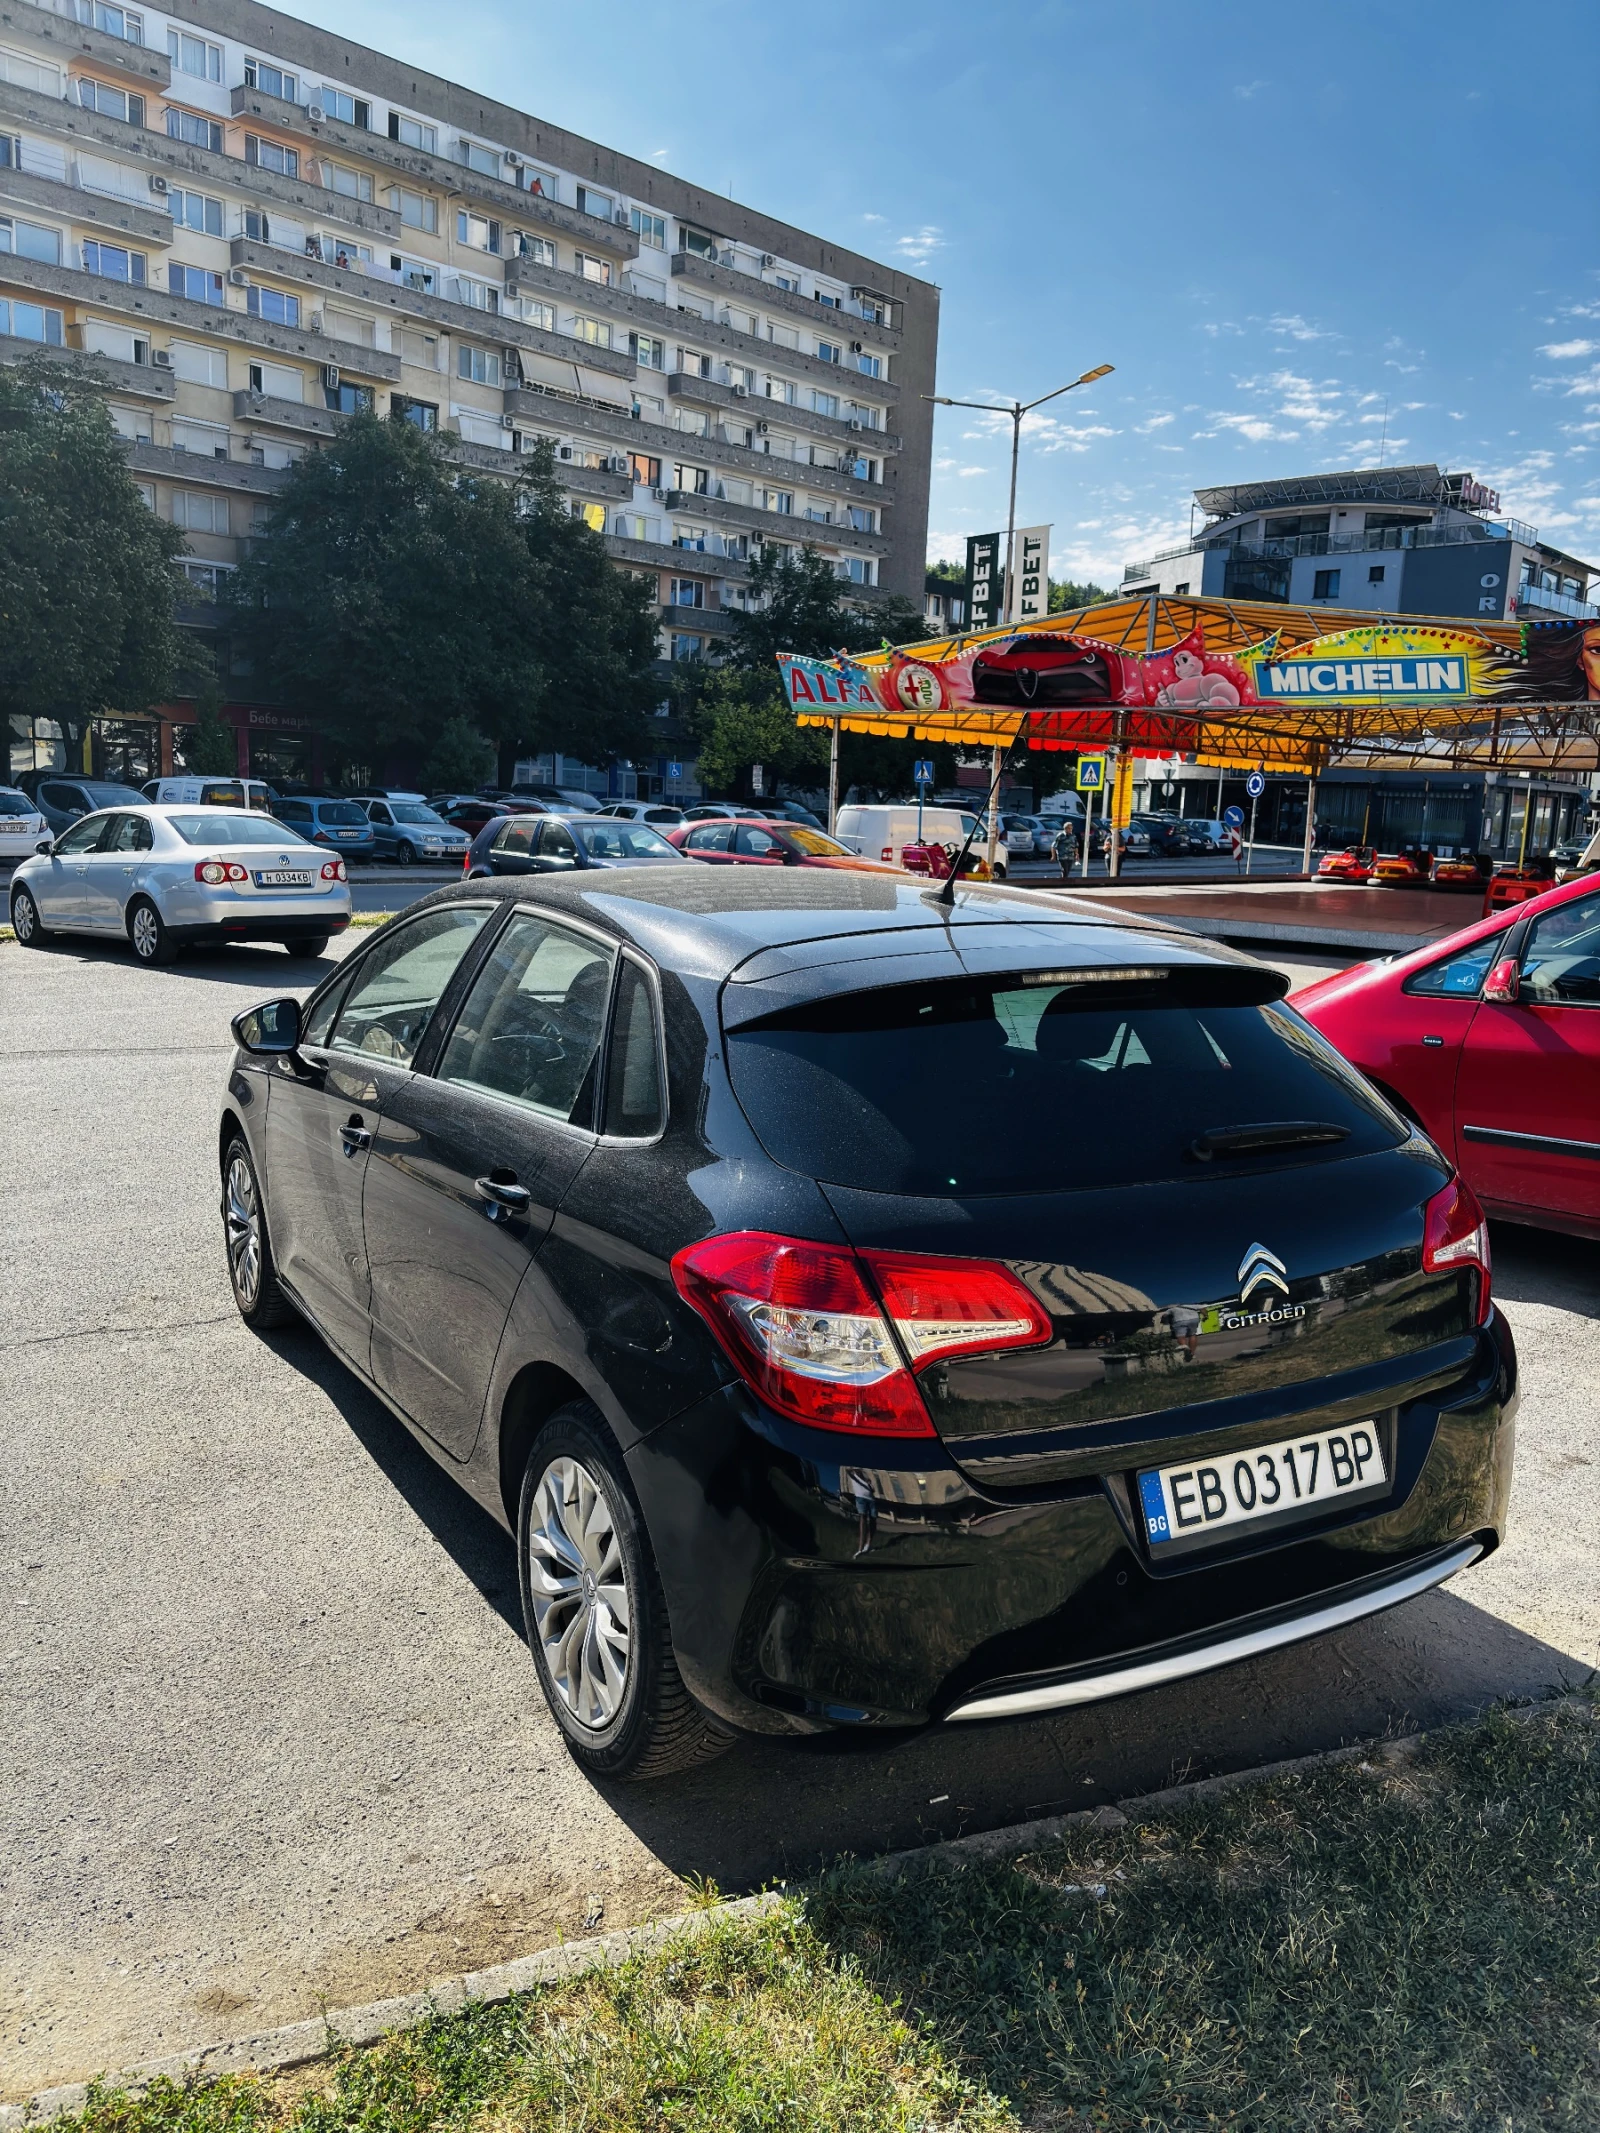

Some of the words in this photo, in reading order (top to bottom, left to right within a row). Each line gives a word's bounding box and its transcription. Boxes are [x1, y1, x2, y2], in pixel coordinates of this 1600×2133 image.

[1461, 476, 1502, 514] HOTEL
[790, 667, 876, 702] ALFA
[1270, 661, 1461, 692] MICHELIN
[249, 710, 279, 725] Бебе
[1226, 1302, 1306, 1330] CITROËN
[1169, 1466, 1228, 1529] EB
[1233, 1442, 1320, 1511] 0317
[1327, 1430, 1373, 1488] BP
[1148, 1516, 1167, 1534] BG
